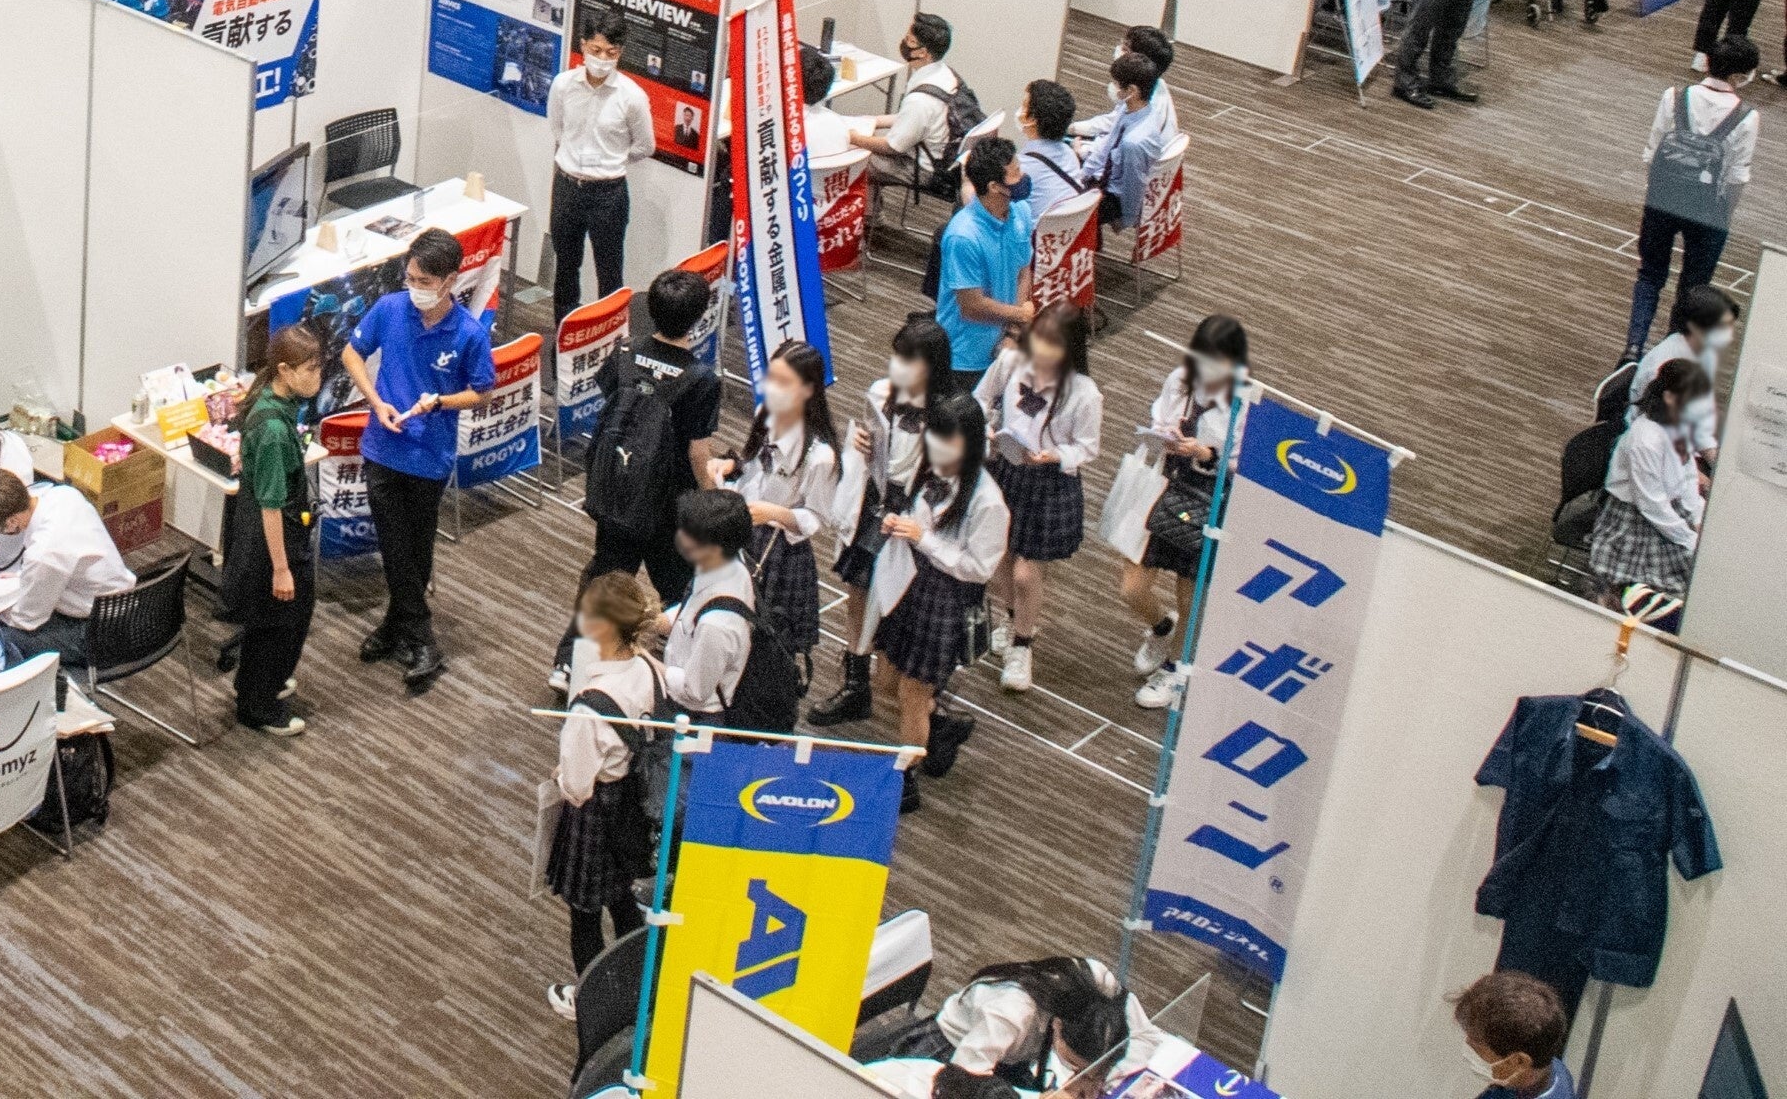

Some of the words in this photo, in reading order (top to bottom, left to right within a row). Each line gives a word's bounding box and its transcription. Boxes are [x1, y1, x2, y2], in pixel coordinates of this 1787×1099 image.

[201, 8, 292, 50] 貢献する
[782, 12, 809, 222] 最先端を支えるものづくり
[734, 218, 750, 293] KOGYO
[471, 382, 533, 423] 精密工業
[468, 407, 532, 448] 株式会社
[472, 437, 528, 471] KOGYO
[1287, 452, 1346, 483] AVOLON
[1184, 537, 1347, 871] アボロン
[755, 791, 837, 811] AVOLON
